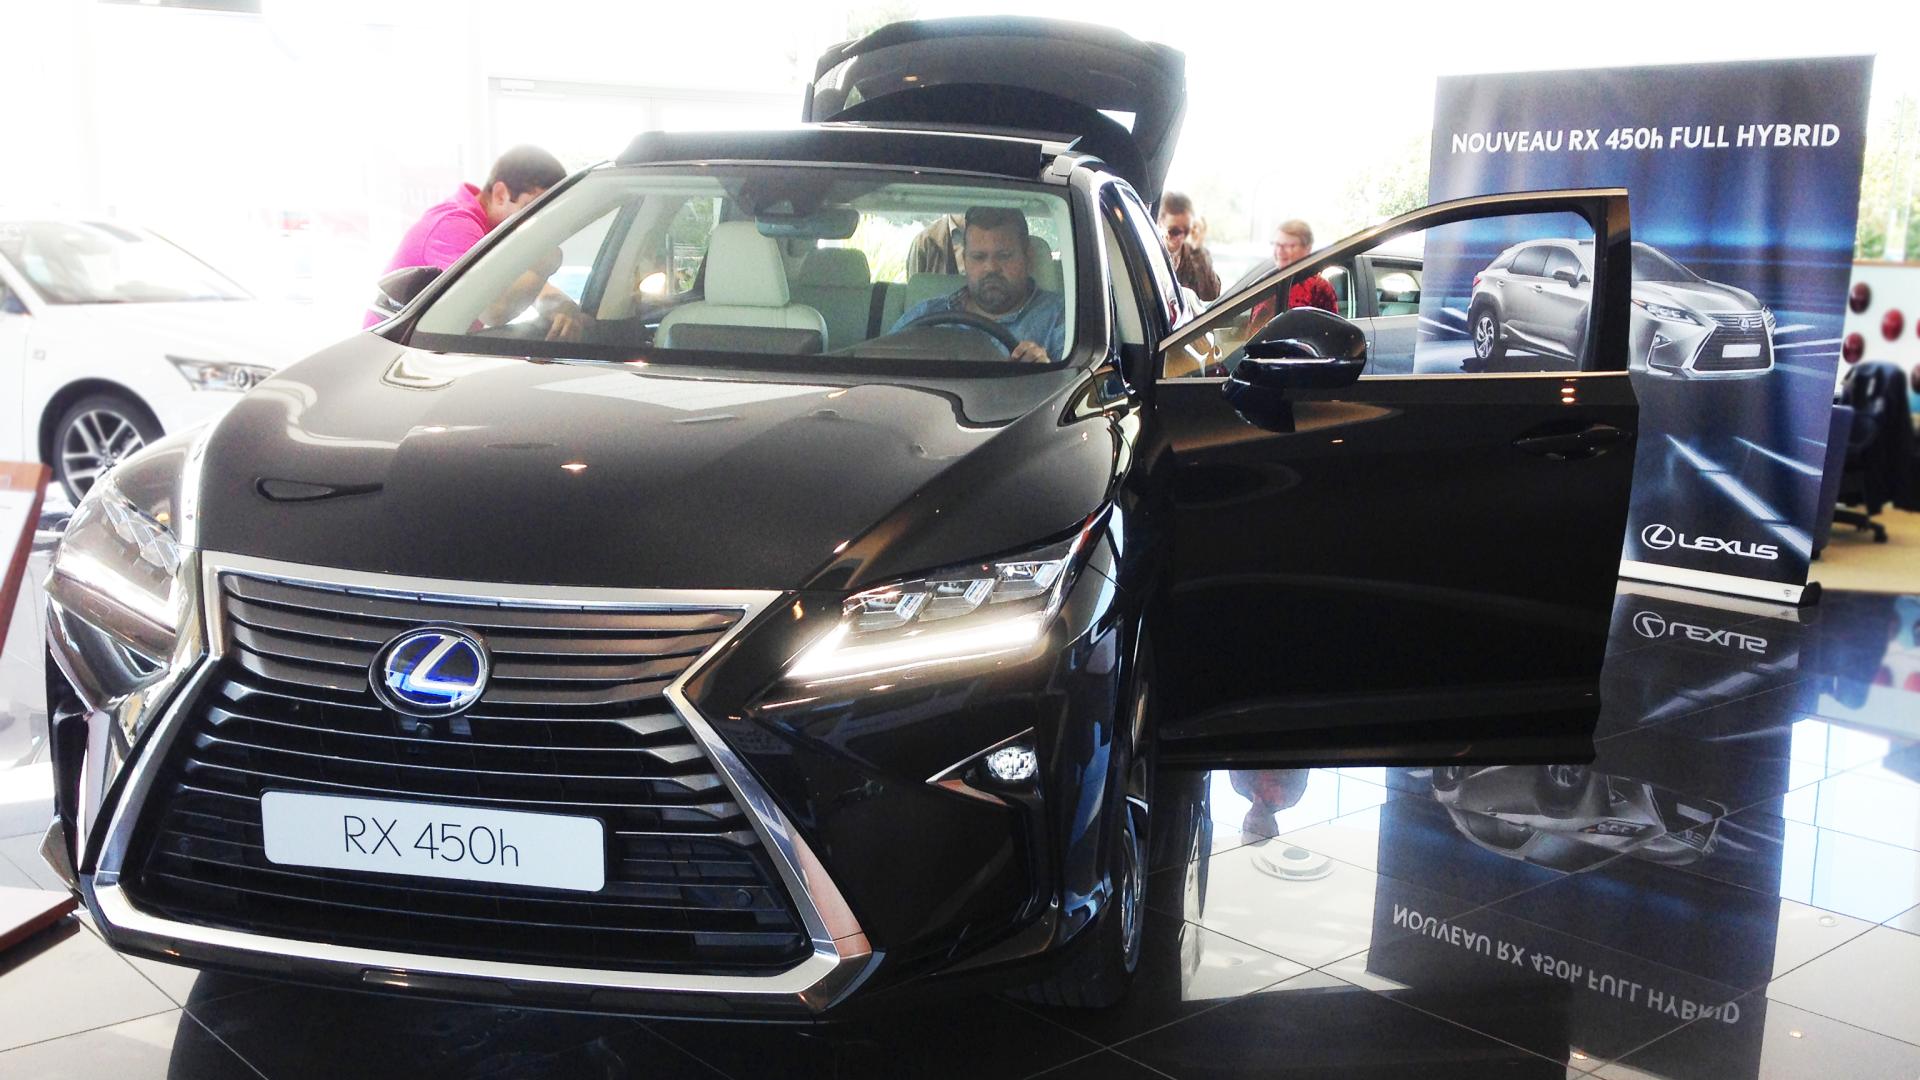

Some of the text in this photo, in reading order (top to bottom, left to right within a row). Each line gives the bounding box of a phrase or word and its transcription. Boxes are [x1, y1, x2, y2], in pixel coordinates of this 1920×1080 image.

[1451, 123, 1841, 153] NOUVEAU RX 450h FULL HYBRID
[1678, 533, 1779, 560] LEXUS
[343, 815, 520, 867] RX 450h
